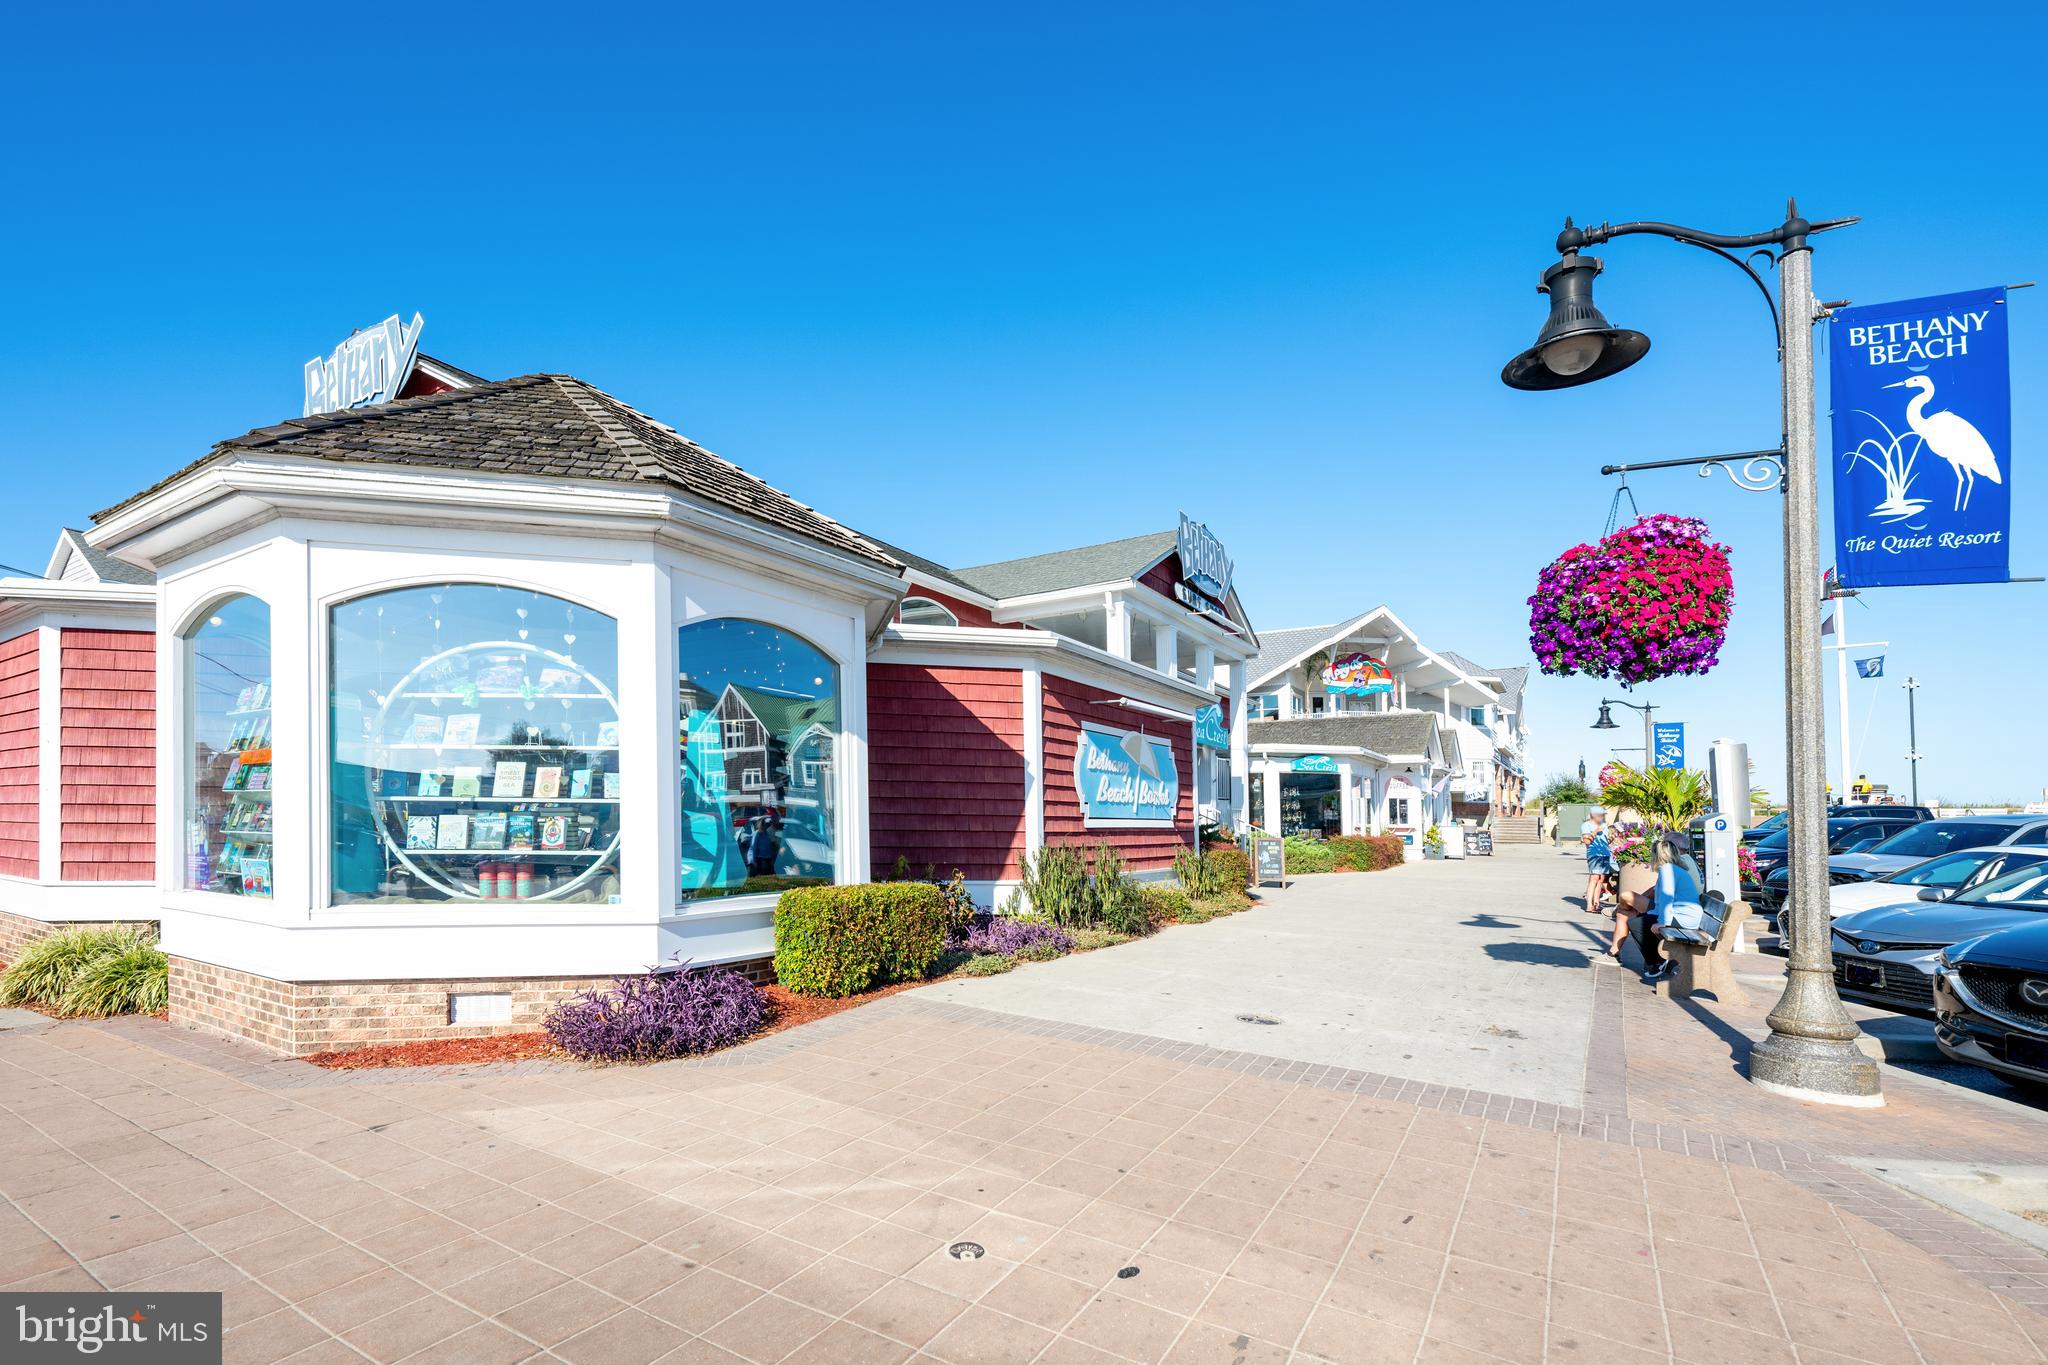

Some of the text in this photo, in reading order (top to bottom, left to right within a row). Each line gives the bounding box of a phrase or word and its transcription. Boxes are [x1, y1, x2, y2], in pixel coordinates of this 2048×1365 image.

[1849, 310, 1989, 347] BETHANY
[1869, 335, 1968, 366] BEACH
[1845, 530, 2002, 555] The Quiet Resort
[1087, 745, 1129, 783] Bethany
[1096, 774, 1170, 806] Beach Books
[1717, 821, 1725, 829] P
